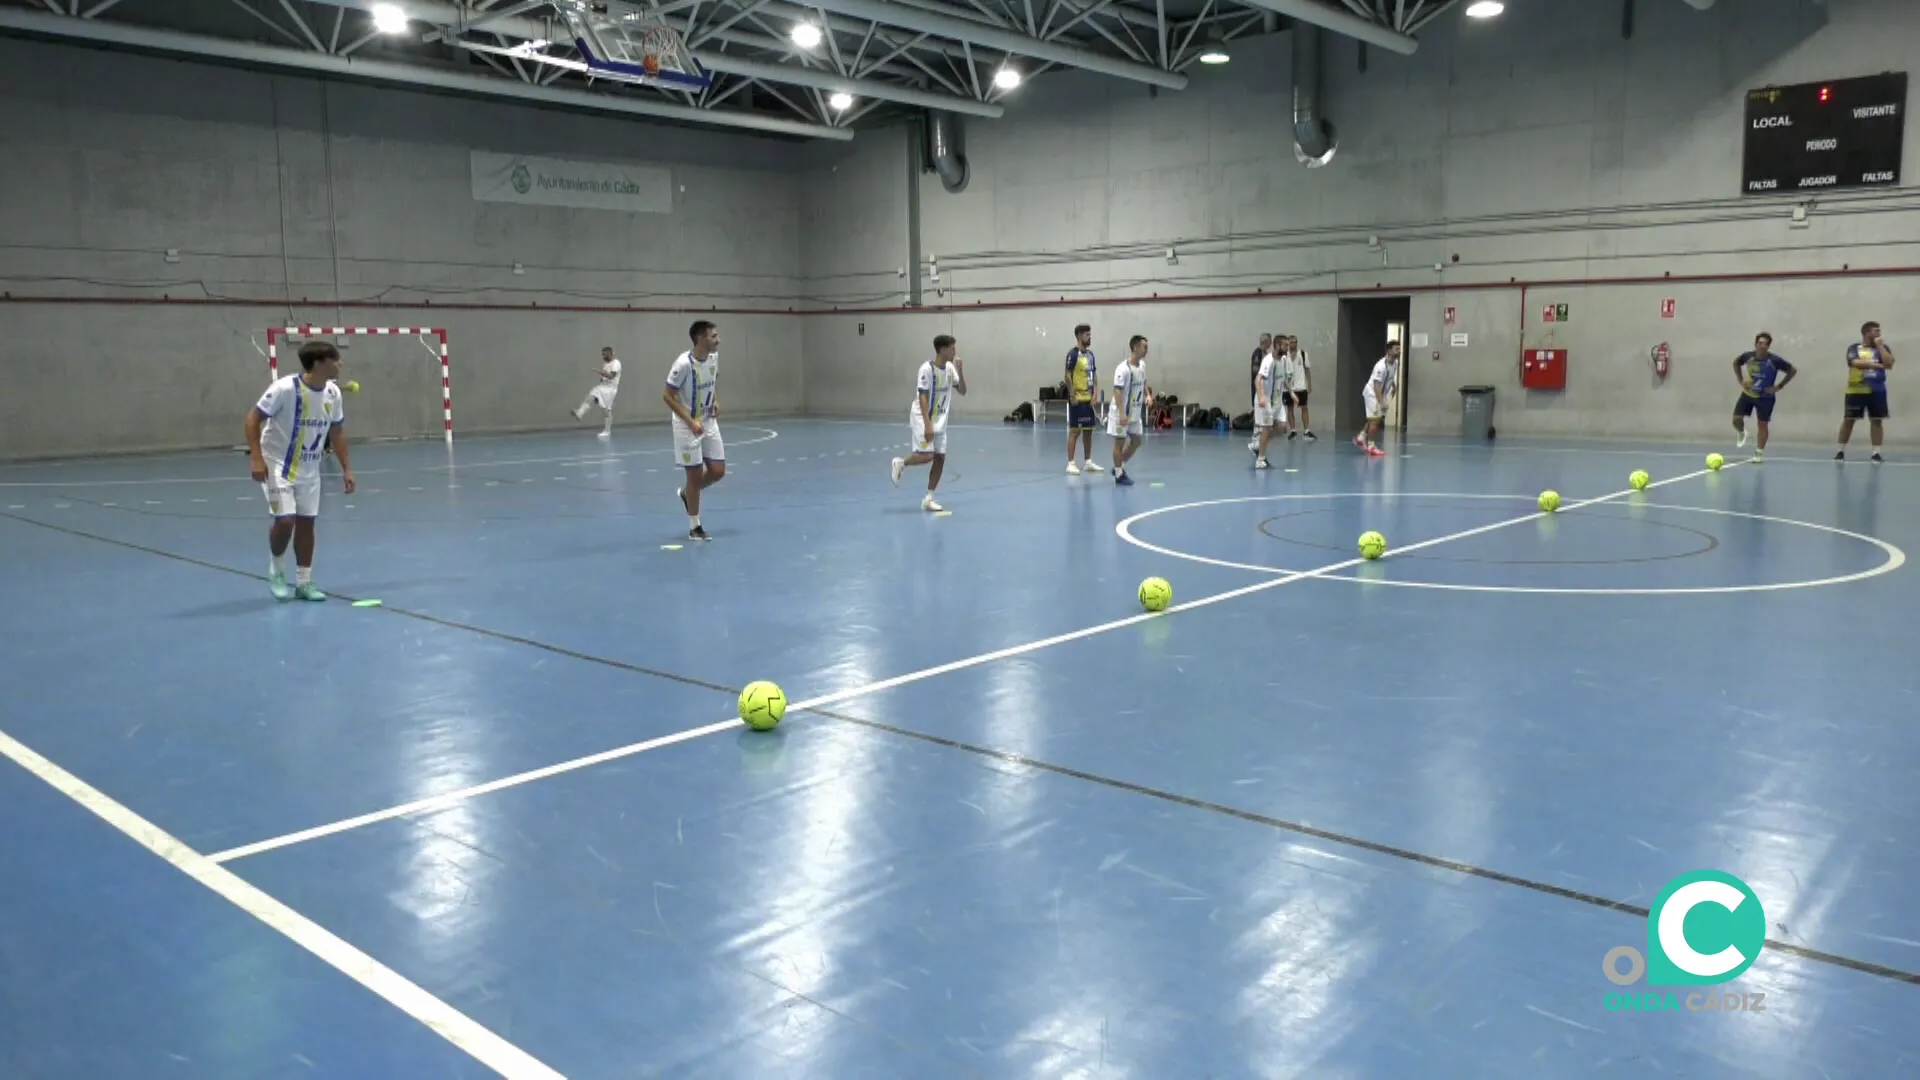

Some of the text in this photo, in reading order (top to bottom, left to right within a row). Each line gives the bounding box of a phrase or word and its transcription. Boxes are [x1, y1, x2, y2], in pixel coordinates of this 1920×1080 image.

[1853, 104, 1897, 118] VISITANTE
[1753, 115, 1793, 128] LOCAL
[1806, 138, 1837, 151] PERIODO
[1798, 175, 1837, 187] JUGADOR
[1862, 171, 1894, 182] FALTAS
[537, 174, 600, 193] Ayuntamiento
[602, 182, 613, 192] de
[1749, 179, 1777, 190] FALTAS
